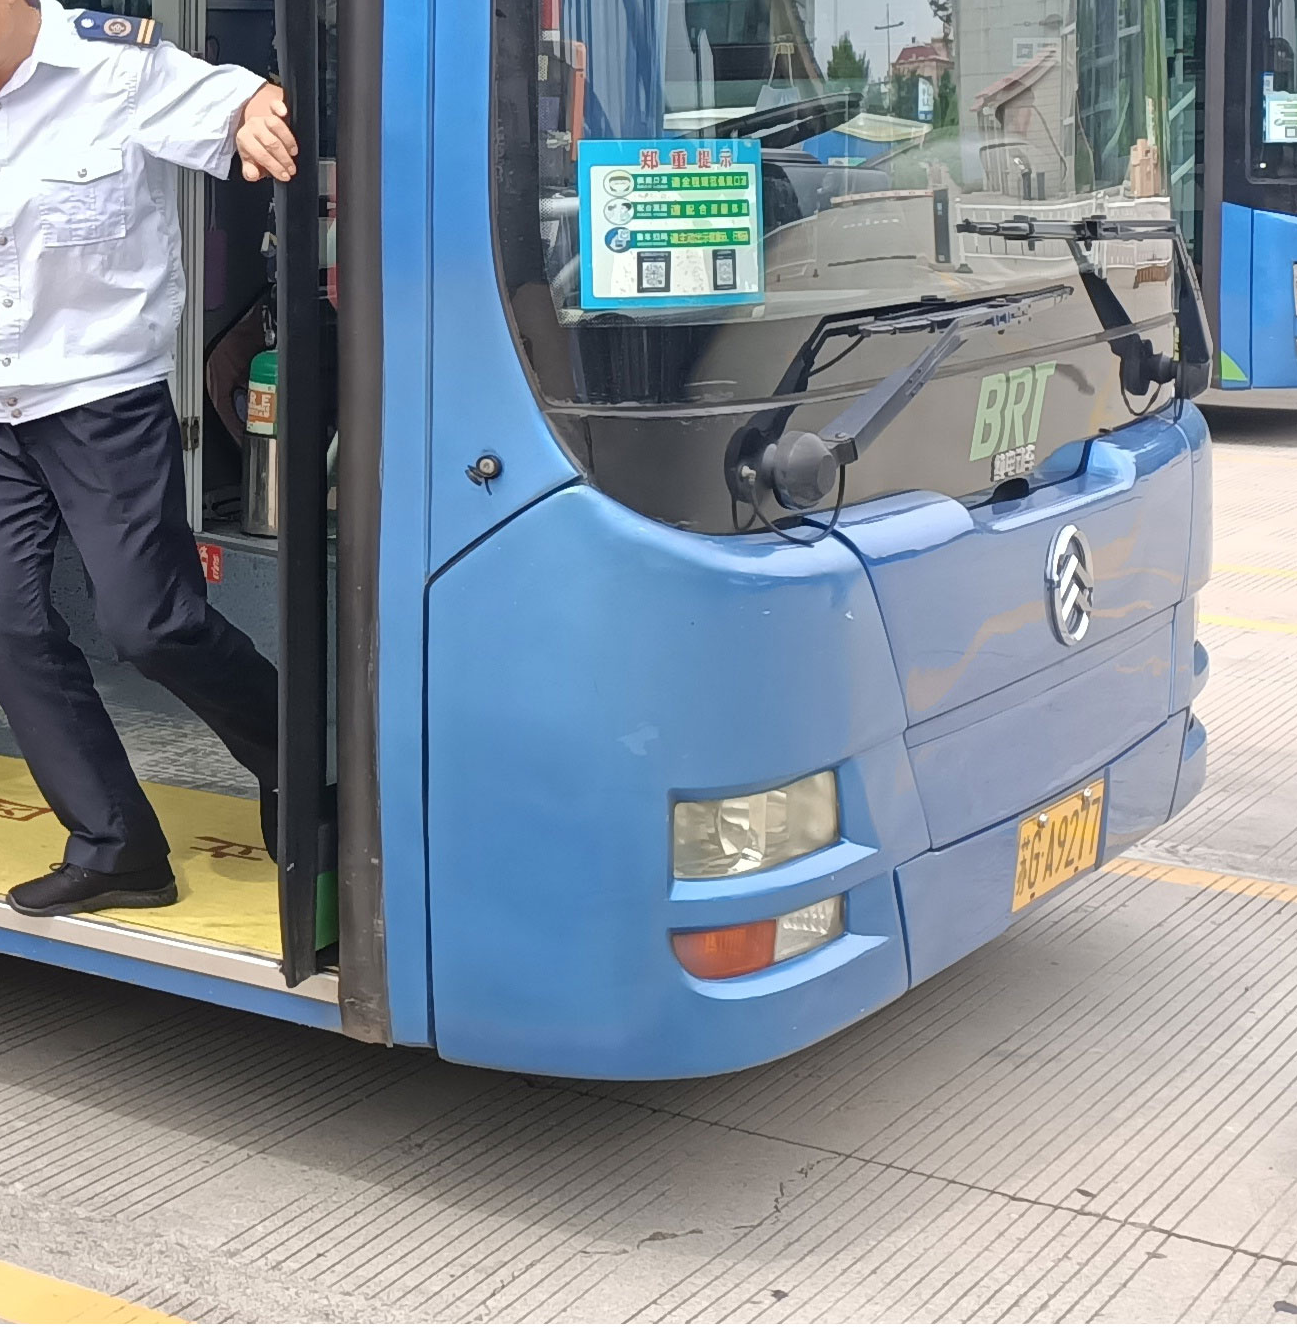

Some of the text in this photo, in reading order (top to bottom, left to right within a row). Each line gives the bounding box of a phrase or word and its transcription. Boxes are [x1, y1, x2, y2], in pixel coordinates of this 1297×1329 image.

[640, 148, 733, 170] 郑重提示
[969, 360, 1057, 462] BRT
